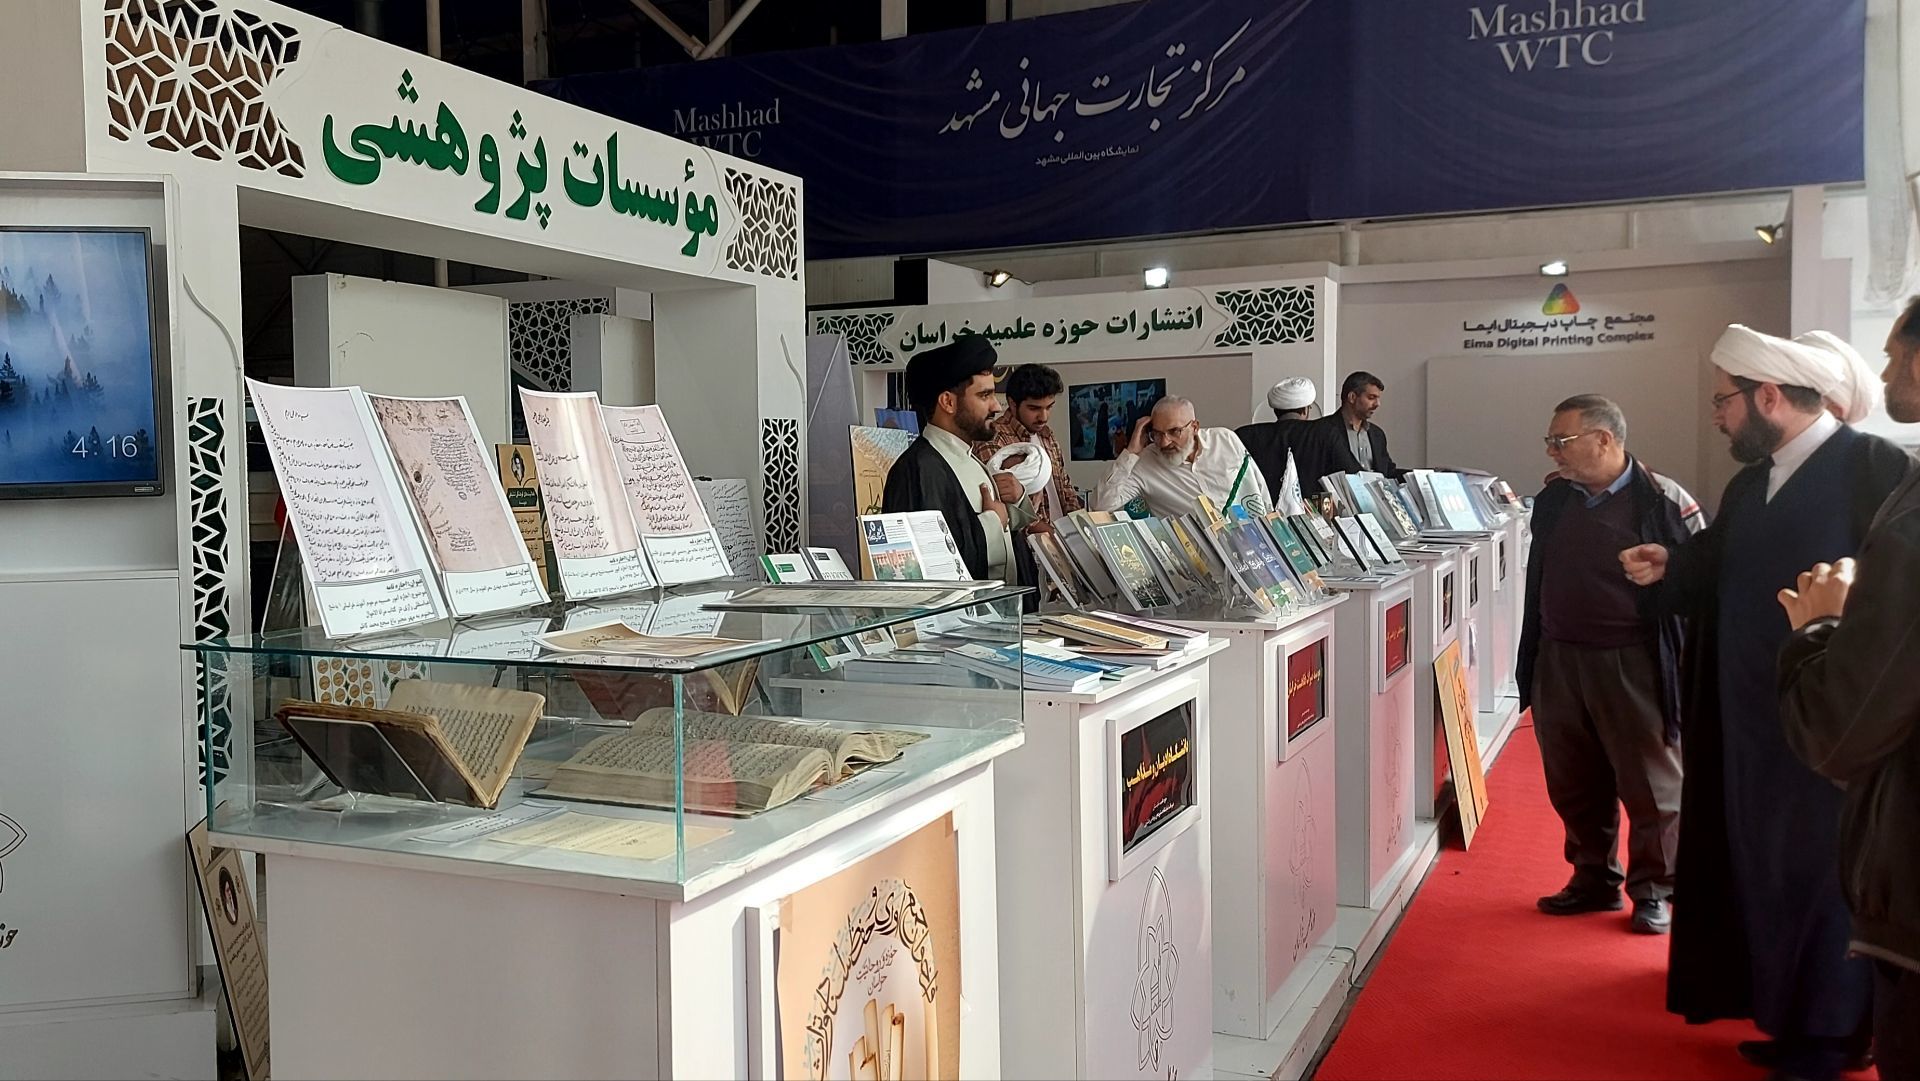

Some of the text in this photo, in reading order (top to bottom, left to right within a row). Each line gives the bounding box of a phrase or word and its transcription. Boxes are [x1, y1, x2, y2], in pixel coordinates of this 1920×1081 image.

[1467, 0, 1646, 40] Mashhad
[1496, 30, 1614, 73] WTC
[938, 17, 1252, 143] مرکز تجارت جهانی مشهد
[673, 98, 781, 135] Mashhad
[322, 68, 719, 258] مؤسسات پژوهشی
[1035, 154, 1060, 167] مشهد
[1101, 144, 1140, 157] نمایشگاه
[977, 315, 1037, 346] علمیه
[1042, 318, 1100, 345] حوزه
[1105, 304, 1204, 341] انتشارات
[1463, 312, 1655, 335] مجتمع چاپ دیجیتال ایما
[1463, 331, 1655, 350] Eima Digital Printing Complex
[71, 435, 138, 459] 4:16
[867, 973, 888, 996] خراسان
